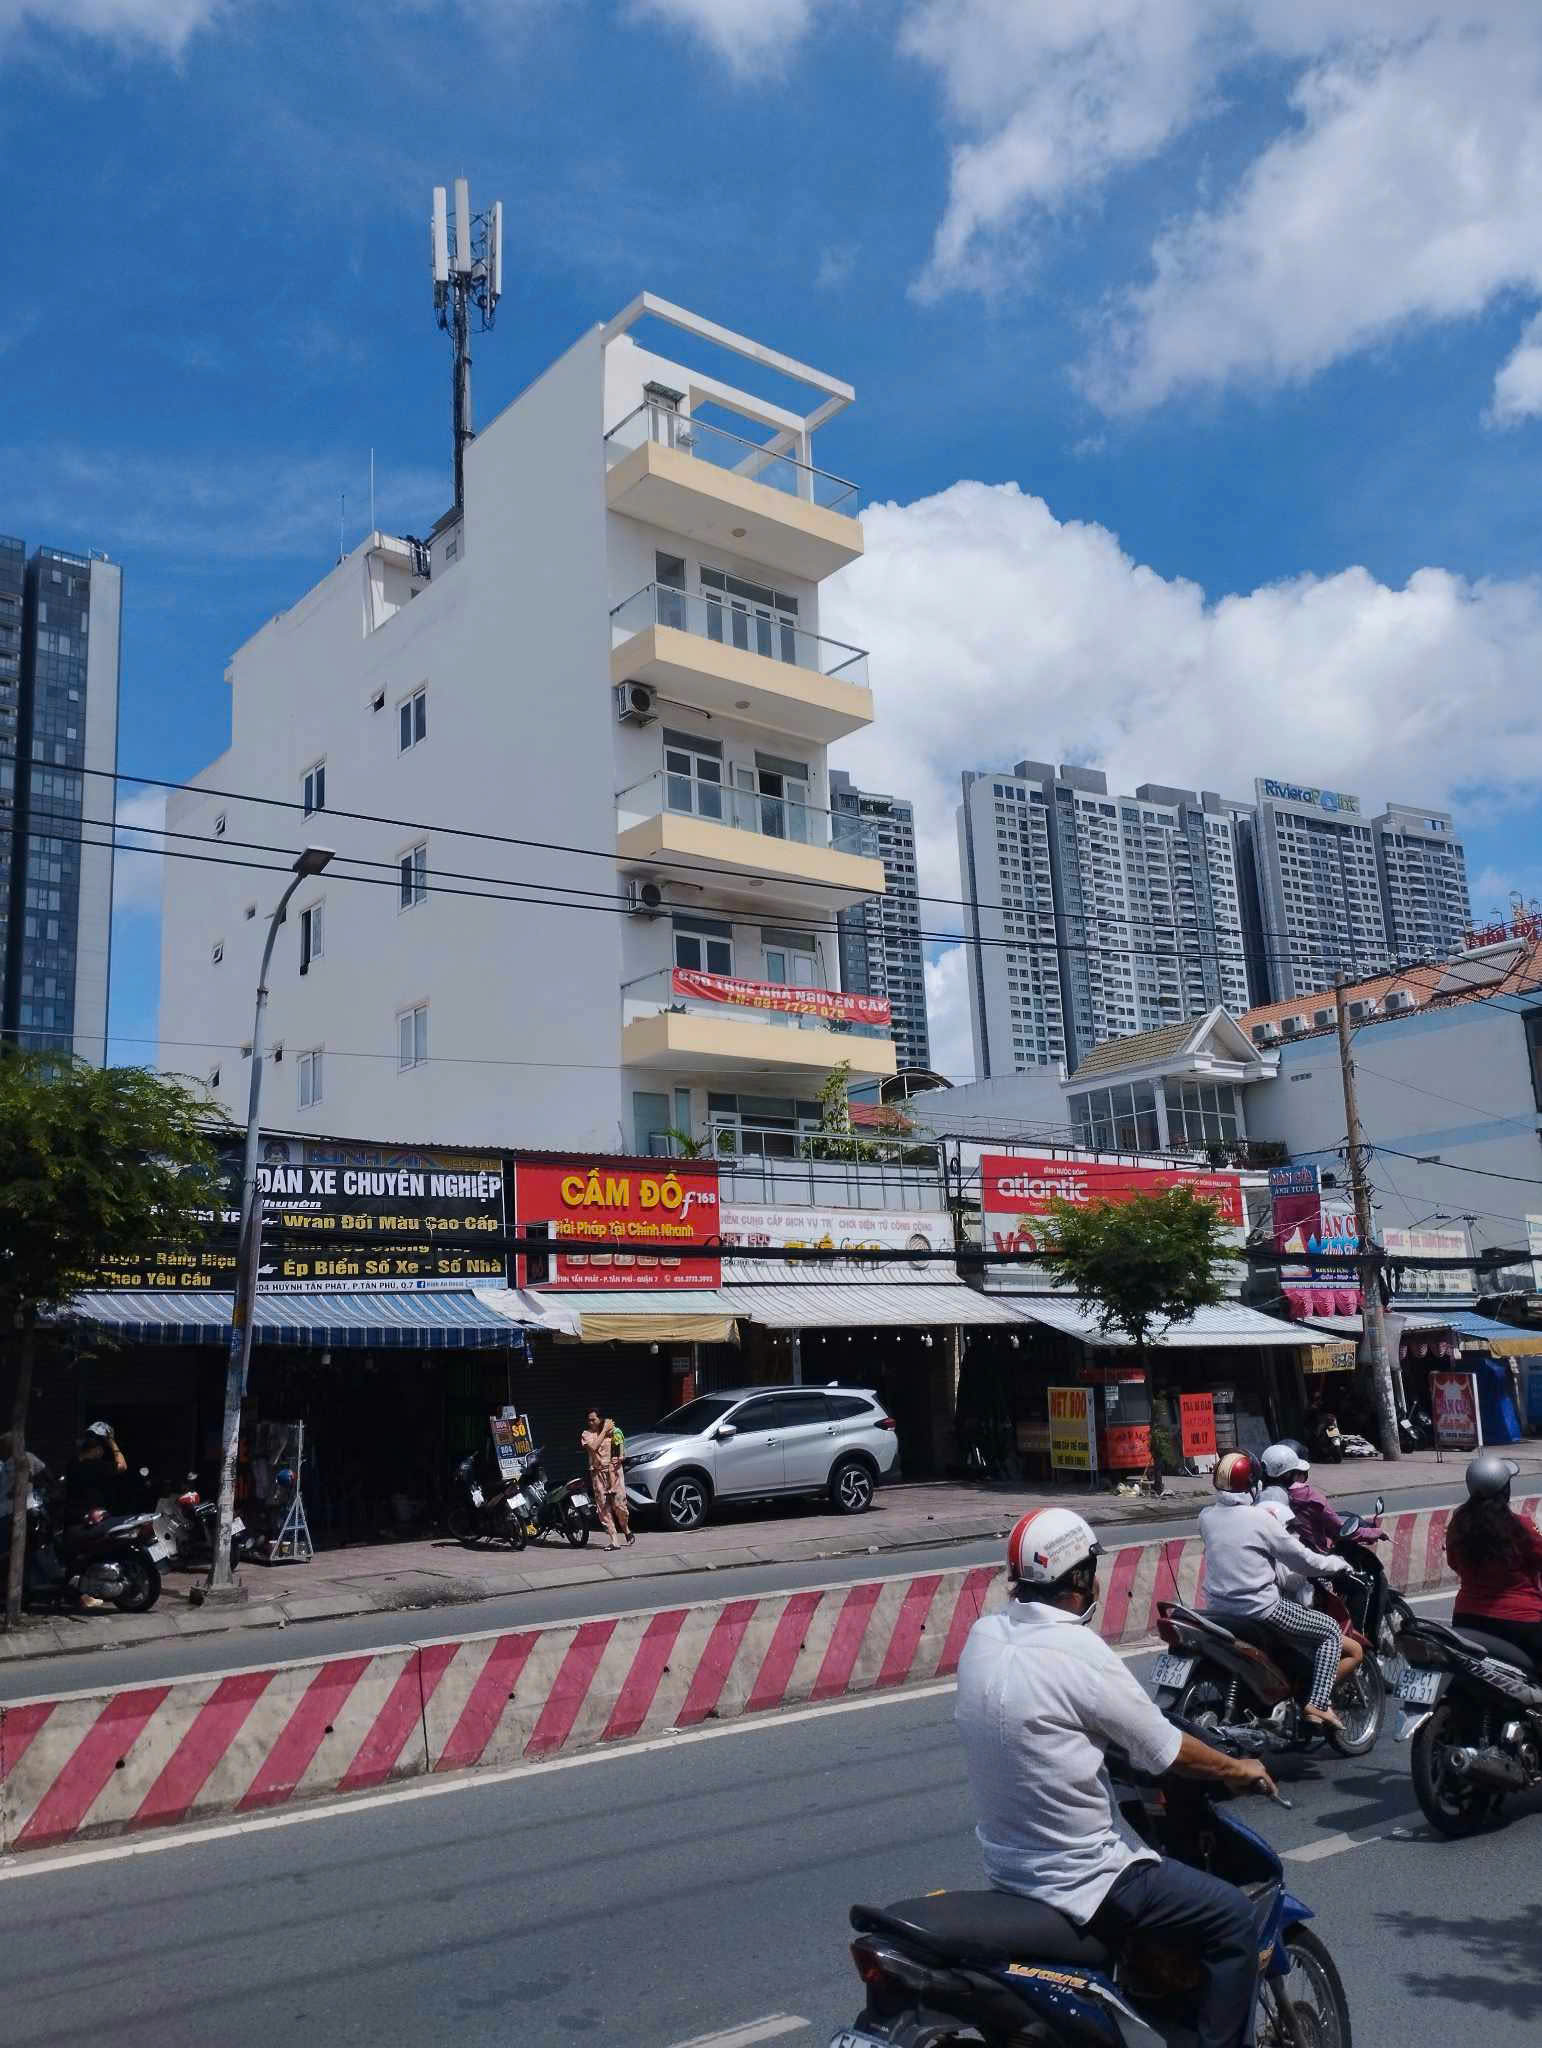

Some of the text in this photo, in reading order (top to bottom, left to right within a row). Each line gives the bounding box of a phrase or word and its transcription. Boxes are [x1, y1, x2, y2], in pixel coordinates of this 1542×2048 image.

[1264, 779, 1312, 802] Riviera
[310, 1169, 336, 1194] XE
[343, 1169, 424, 1197] CHUYÊN
[430, 1172, 501, 1203] NGHIỆP
[561, 1168, 629, 1207] CẦM
[998, 1172, 1089, 1202] atlantic
[576, 1220, 606, 1237] Pháp
[661, 1223, 694, 1237] Nhanh
[147, 1272, 176, 1285] Yêu
[283, 1258, 309, 1277] Ép
[314, 1257, 359, 1275] Biển
[365, 1257, 390, 1275] Số
[396, 1260, 419, 1274] Xe
[438, 1257, 461, 1273] Số
[467, 1257, 502, 1273] Nhà
